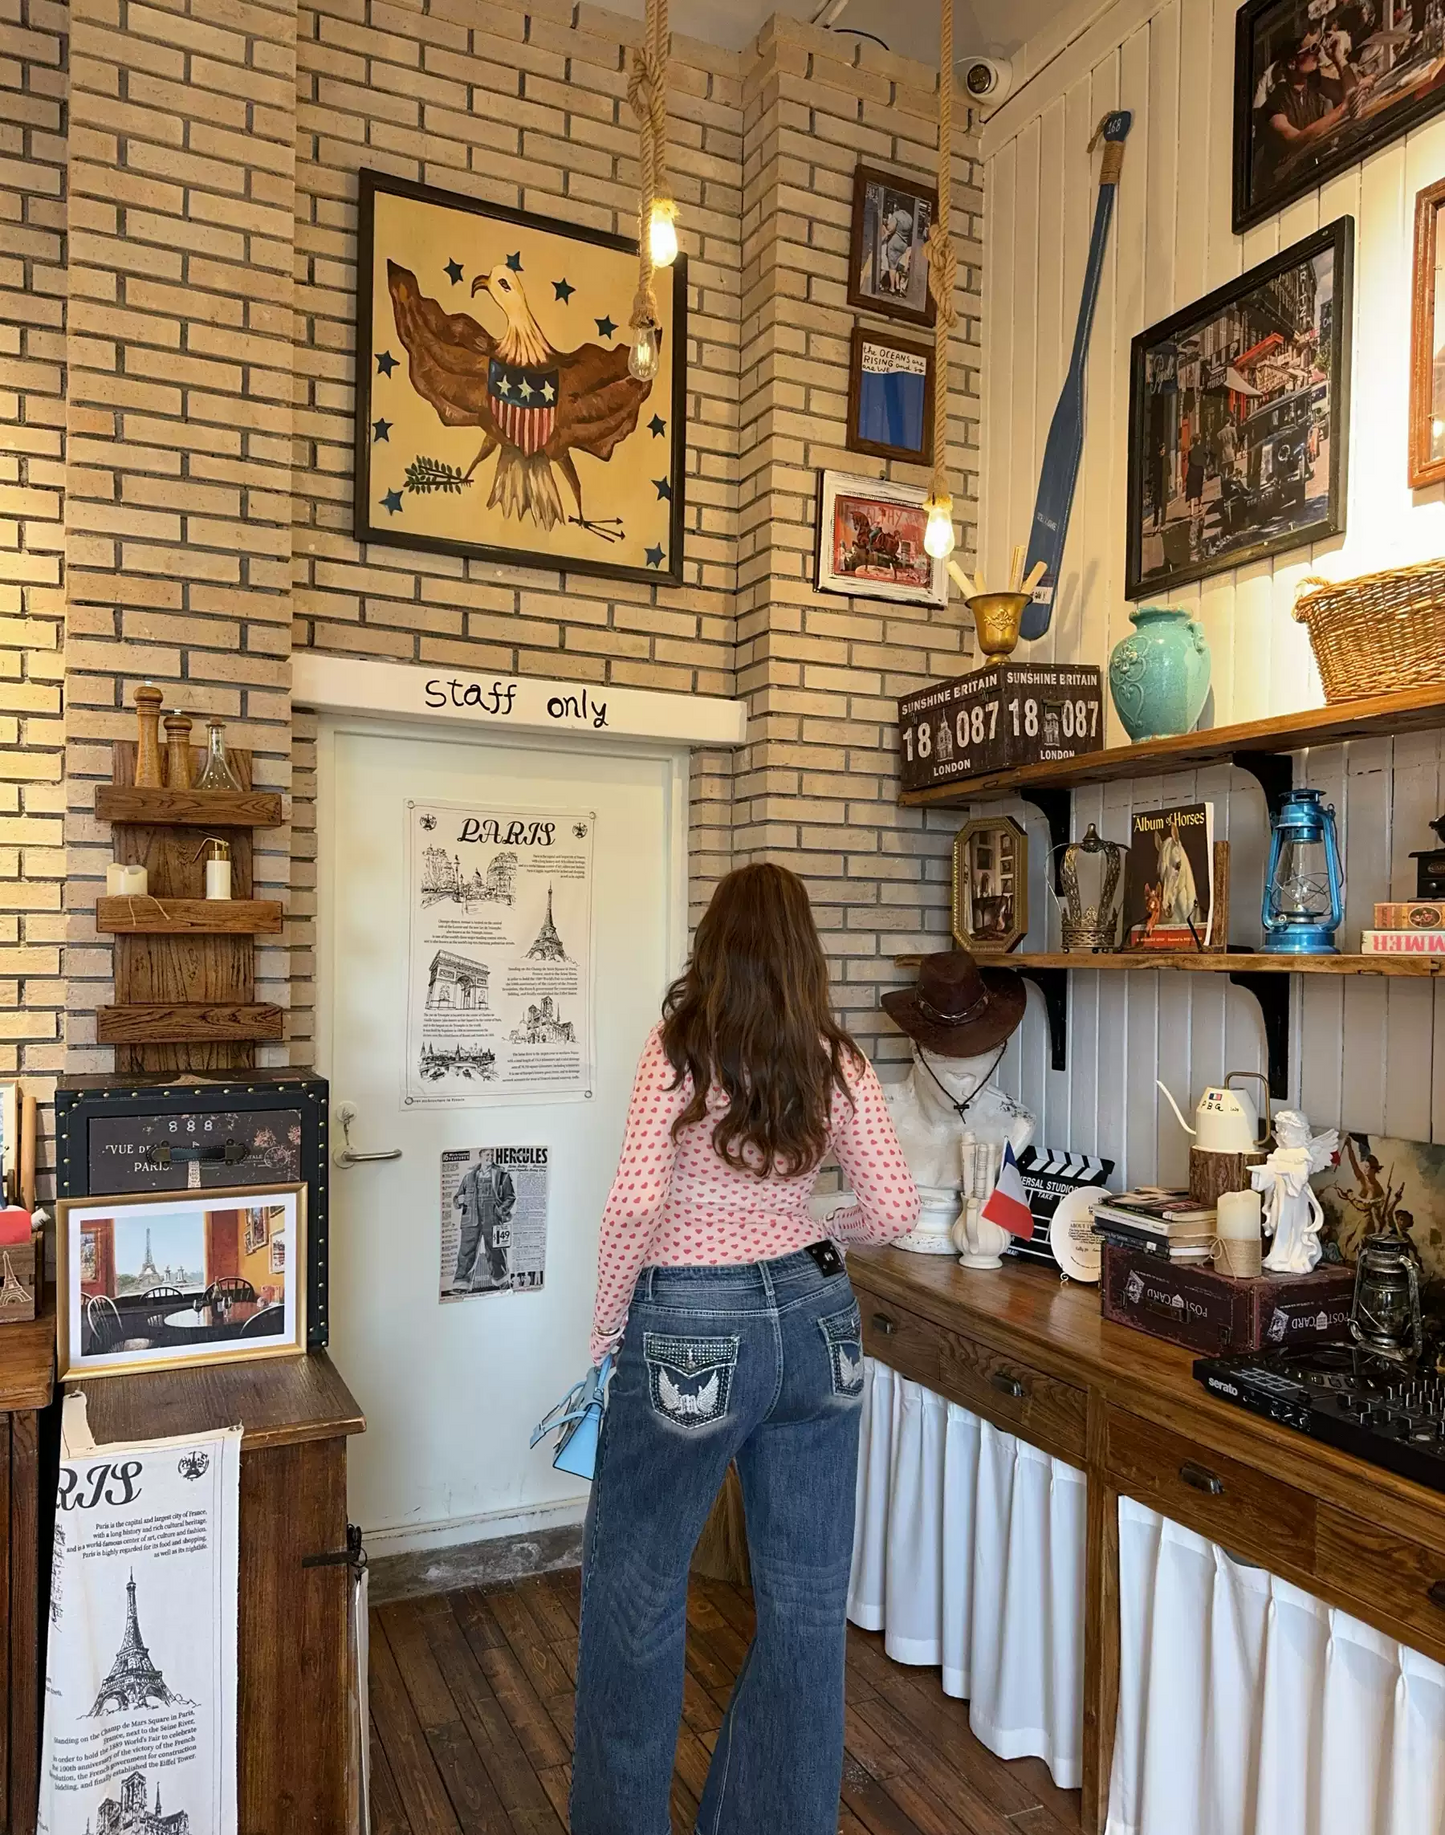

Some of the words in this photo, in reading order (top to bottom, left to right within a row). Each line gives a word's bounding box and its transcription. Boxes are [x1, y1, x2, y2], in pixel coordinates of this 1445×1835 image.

[1107, 118, 1122, 134] 168
[863, 346, 877, 356] the
[880, 349, 910, 363] OCEANS
[863, 355, 893, 367] RISING
[895, 362, 911, 371] and
[1007, 672, 1056, 685] SUNSHINE
[1060, 673, 1098, 686] BRITAIN
[902, 690, 951, 715] SUNSHINE
[954, 674, 998, 697] BRITAIN
[547, 688, 609, 728] only
[1008, 698, 1039, 737] 18
[903, 722, 932, 762] 18
[956, 700, 999, 748] 087
[1040, 750, 1075, 760] LONDON
[933, 758, 971, 777] LONDON
[1134, 815, 1164, 832] Album
[1165, 813, 1172, 826] of
[1174, 810, 1205, 827] Horses
[456, 818, 556, 846] PARIS
[496, 1148, 548, 1164] HERCULES
[1038, 1191, 1054, 1200] TAKE
[1147, 1288, 1171, 1305] CARD
[1186, 1301, 1208, 1317] POST
[1292, 1316, 1316, 1329] CARD
[1208, 1377, 1238, 1396] serato
[125, 1518, 142, 1527] capital
[154, 1514, 171, 1522] largest
[164, 1520, 184, 1529] cultural
[83, 1551, 95, 1559] Paris
[102, 1548, 118, 1556] highly
[120, 1545, 142, 1554] regarded
[159, 1540, 171, 1548] food
[172, 1538, 181, 1546] and
[101, 1725, 121, 1736] Champ
[148, 1717, 170, 1725] Square
[178, 1710, 195, 1718] Paris,
[84, 1750, 99, 1760] hold
[100, 1748, 108, 1756] the
[110, 1741, 123, 1751] 1889
[124, 1736, 147, 1746] World's
[169, 1727, 197, 1739] celebrate
[104, 1733, 125, 1745] France,
[160, 1724, 177, 1732] Seine
[78, 1754, 112, 1771] anniversary
[113, 1750, 120, 1758] of
[133, 1745, 154, 1753] victory
[155, 1742, 162, 1750] of
[174, 1736, 196, 1746] French
[89, 1765, 109, 1778] French
[111, 1755, 146, 1770] government
[158, 1745, 197, 1758] construction
[81, 1780, 93, 1788] and
[94, 1774, 111, 1786] finally
[113, 1762, 147, 1777] established
[160, 1758, 176, 1766] Eiffel
